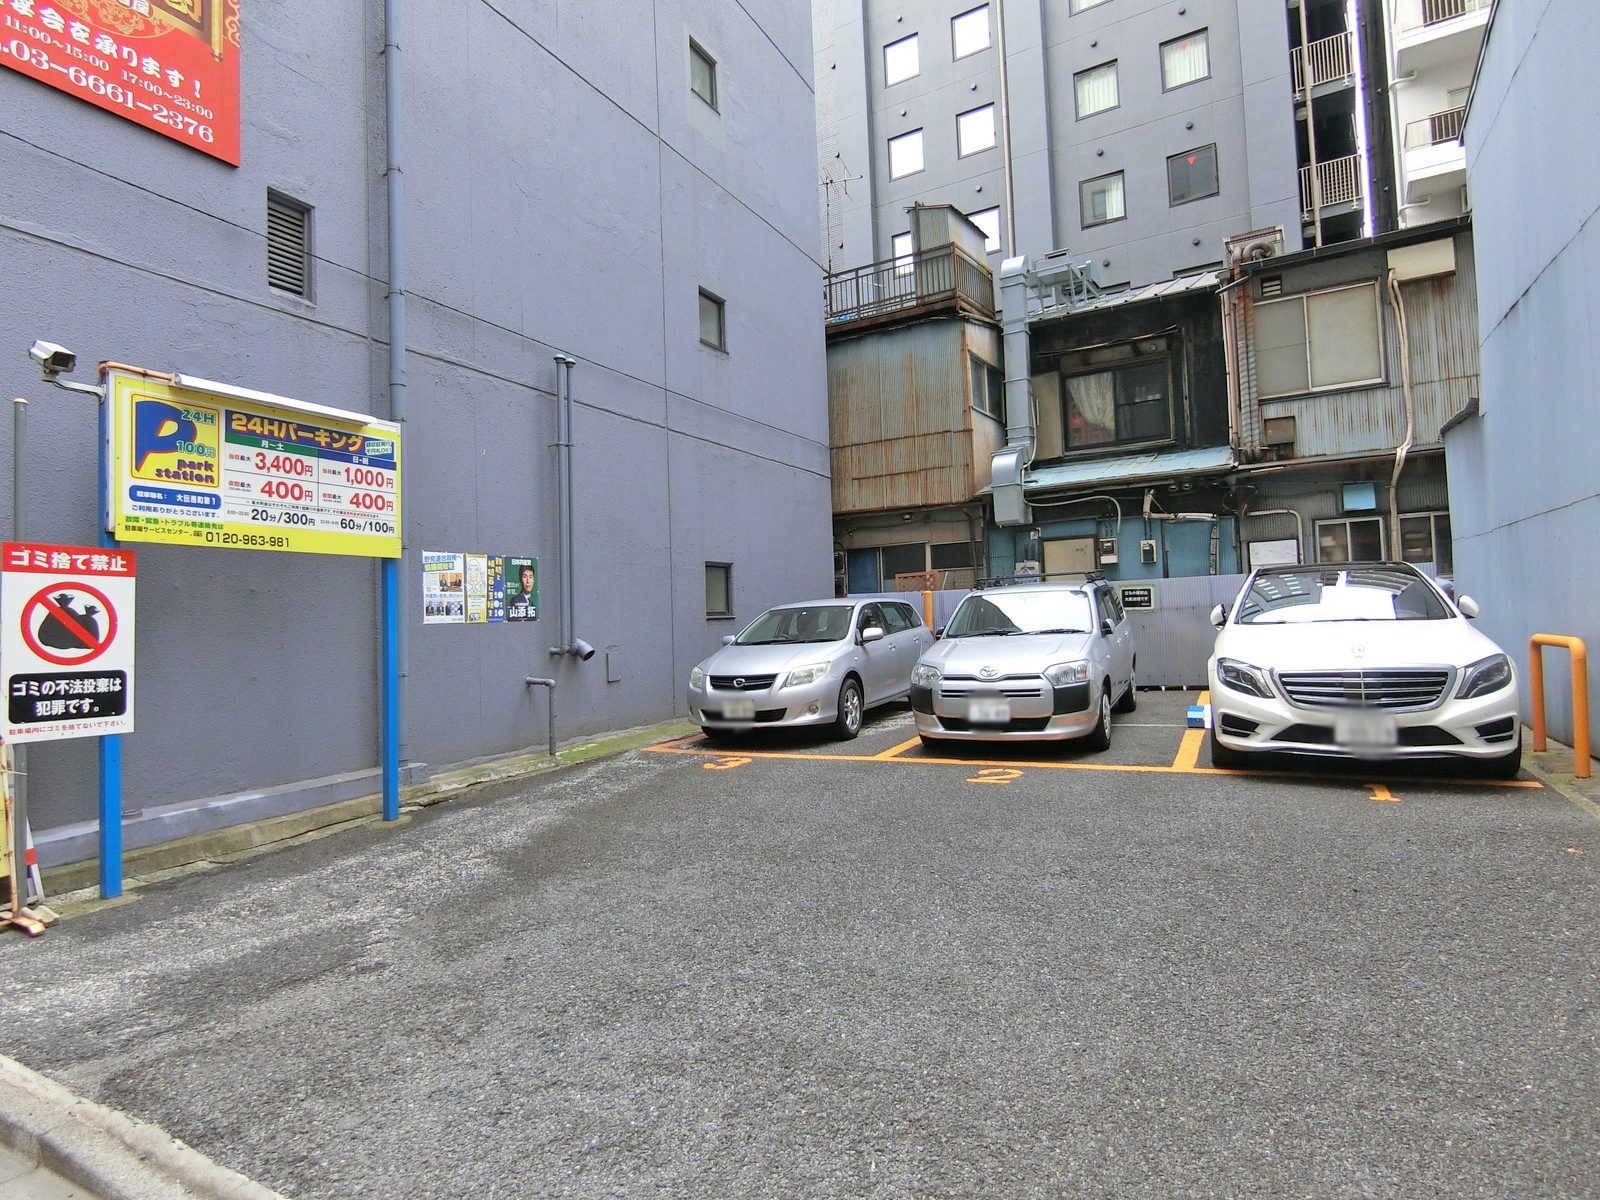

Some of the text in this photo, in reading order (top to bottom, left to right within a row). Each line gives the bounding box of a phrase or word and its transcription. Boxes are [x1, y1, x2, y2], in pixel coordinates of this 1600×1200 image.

[0, 0, 201, 98] 宴会を承ります！
[0, 39, 214, 143] .03-6661-2376
[121, 69, 213, 120] 17:00~23:00
[181, 409, 215, 425] 24H
[231, 412, 365, 454] 24Hパーキング
[176, 440, 215, 458] 100円
[177, 459, 214, 473] park
[255, 452, 313, 477] 3,400円
[155, 467, 215, 484] station
[344, 467, 394, 489] 1,000円
[260, 480, 313, 502] 400円
[349, 492, 394, 512] 400円
[251, 508, 315, 527] 20分/300円
[340, 517, 395, 534] 60分/100円
[205, 530, 290, 548] 0120-963-981
[11, 549, 128, 572] ゴミ捨て禁止
[13, 677, 123, 698] ゴミの不法投棄は
[35, 697, 100, 717] 犯罪です。
[703, 757, 752, 770] 3
[966, 768, 1024, 784] 2
